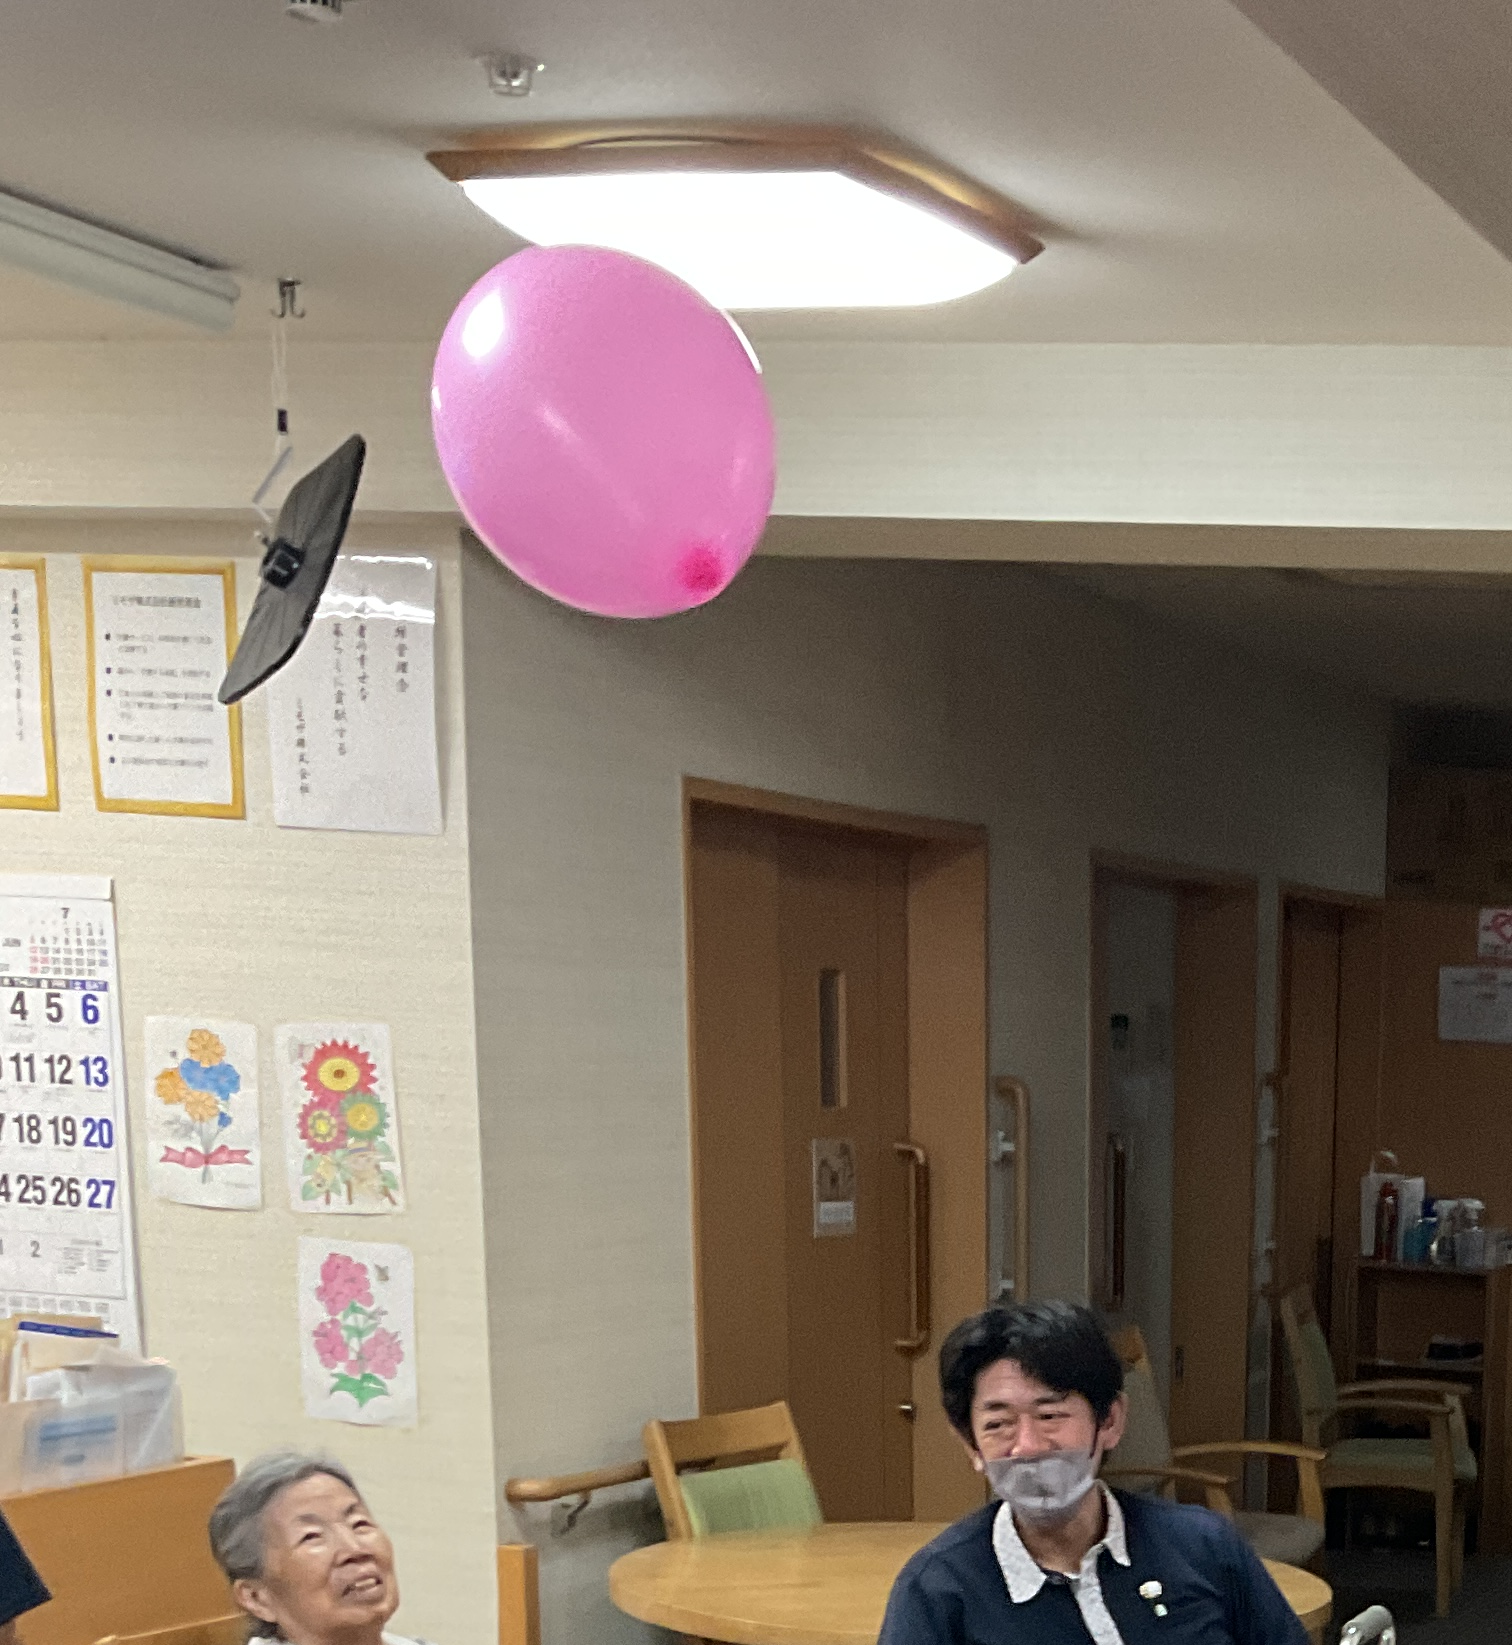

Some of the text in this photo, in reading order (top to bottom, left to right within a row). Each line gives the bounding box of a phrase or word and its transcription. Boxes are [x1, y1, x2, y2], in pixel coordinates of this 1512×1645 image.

[61, 908, 70, 919] 7
[10, 991, 100, 1025] 4 5 6
[9, 1052, 109, 1087] 11 12 13
[12, 1113, 42, 1145] 18
[48, 1115, 77, 1147] 19
[82, 1117, 114, 1149] 20
[16, 1174, 47, 1205] 25
[51, 1176, 81, 1208] 26
[86, 1178, 116, 1210] 27
[30, 1240, 41, 1258] 2
